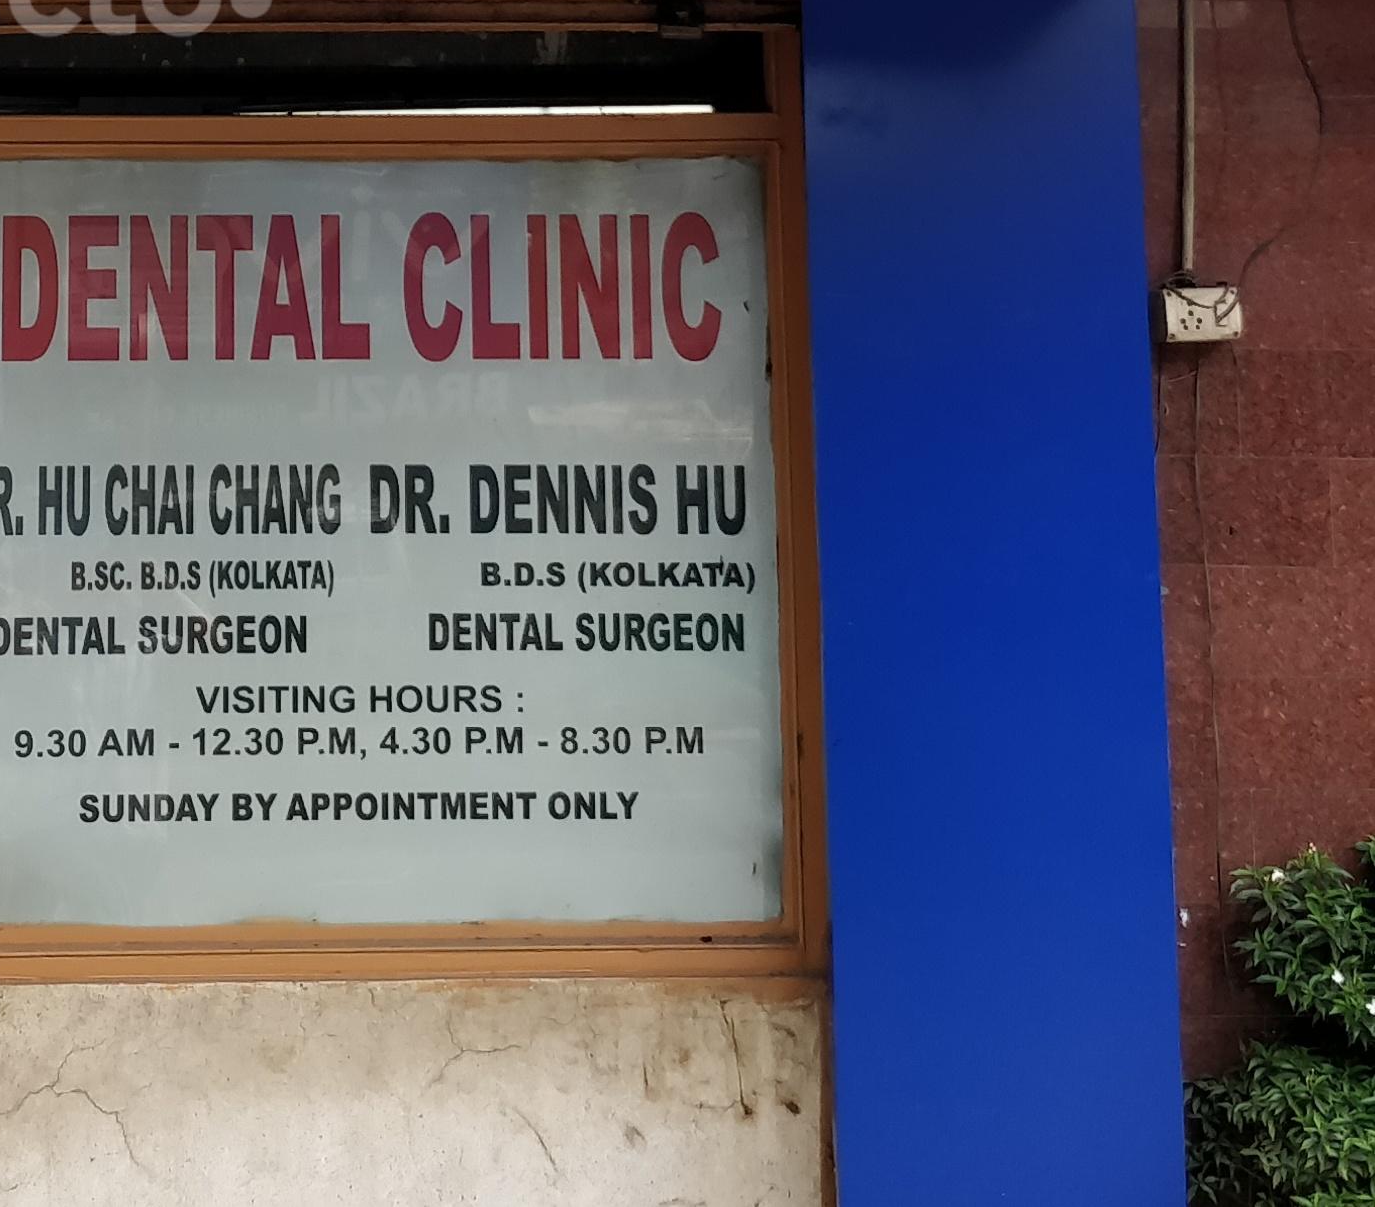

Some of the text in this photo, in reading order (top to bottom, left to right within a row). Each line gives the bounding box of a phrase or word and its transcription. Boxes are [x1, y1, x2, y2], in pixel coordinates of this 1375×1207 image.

[0, 213, 371, 362] DENTAL
[403, 211, 723, 361] CLINIC
[39, 466, 90, 536] HU
[105, 464, 194, 535] CHAI
[209, 464, 341, 535] CHANG
[370, 464, 746, 536] DR. DENNIS HU
[72, 560, 333, 598] B.SC. B.D.S (KOLKATA)
[481, 561, 756, 593] B.D.S (KOLKATA)
[138, 615, 306, 654] SURGEON
[429, 613, 744, 651] DENTAL SURGEON
[196, 686, 355, 713] VISITING
[370, 685, 501, 713] HOURS
[15, 730, 86, 757] 9.30
[98, 729, 154, 756] AM
[193, 728, 283, 755] 12.30
[298, 728, 366, 760] P.M,
[380, 727, 451, 754] 4.30
[466, 727, 522, 753] P.M
[561, 727, 630, 754] 8.30
[646, 727, 703, 754] P.M
[80, 792, 638, 822] SUNDAY BY APPOINTMENT ONLY
